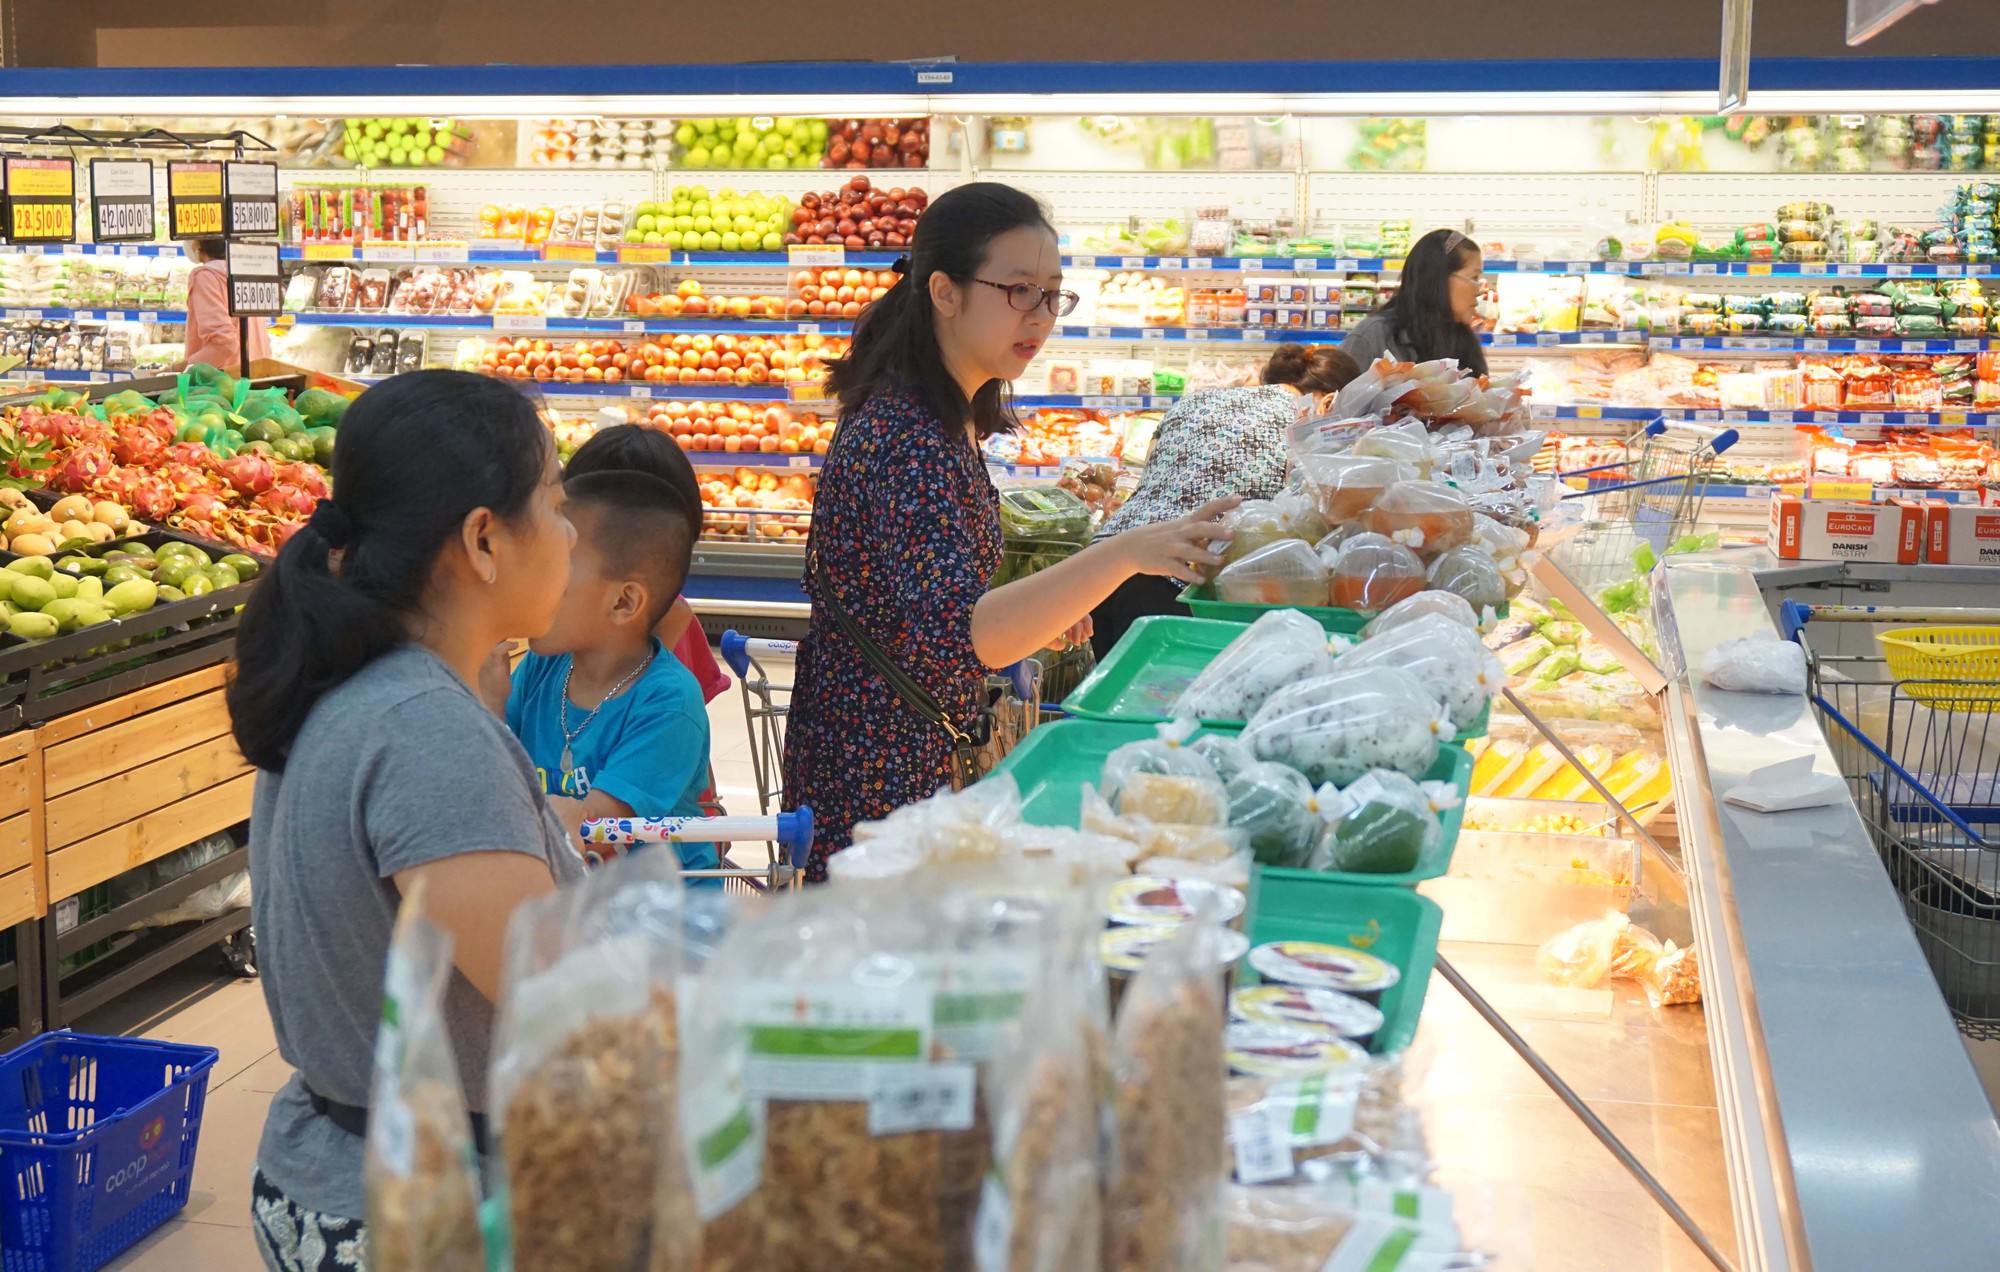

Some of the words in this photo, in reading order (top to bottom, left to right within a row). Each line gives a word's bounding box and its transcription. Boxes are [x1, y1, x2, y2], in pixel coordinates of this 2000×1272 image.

[16, 209, 62, 231] 28.500
[101, 209, 143, 229] 42.000
[178, 207, 216, 228] 49.500
[234, 206, 269, 224] 55.800
[236, 286, 271, 303] 55.800
